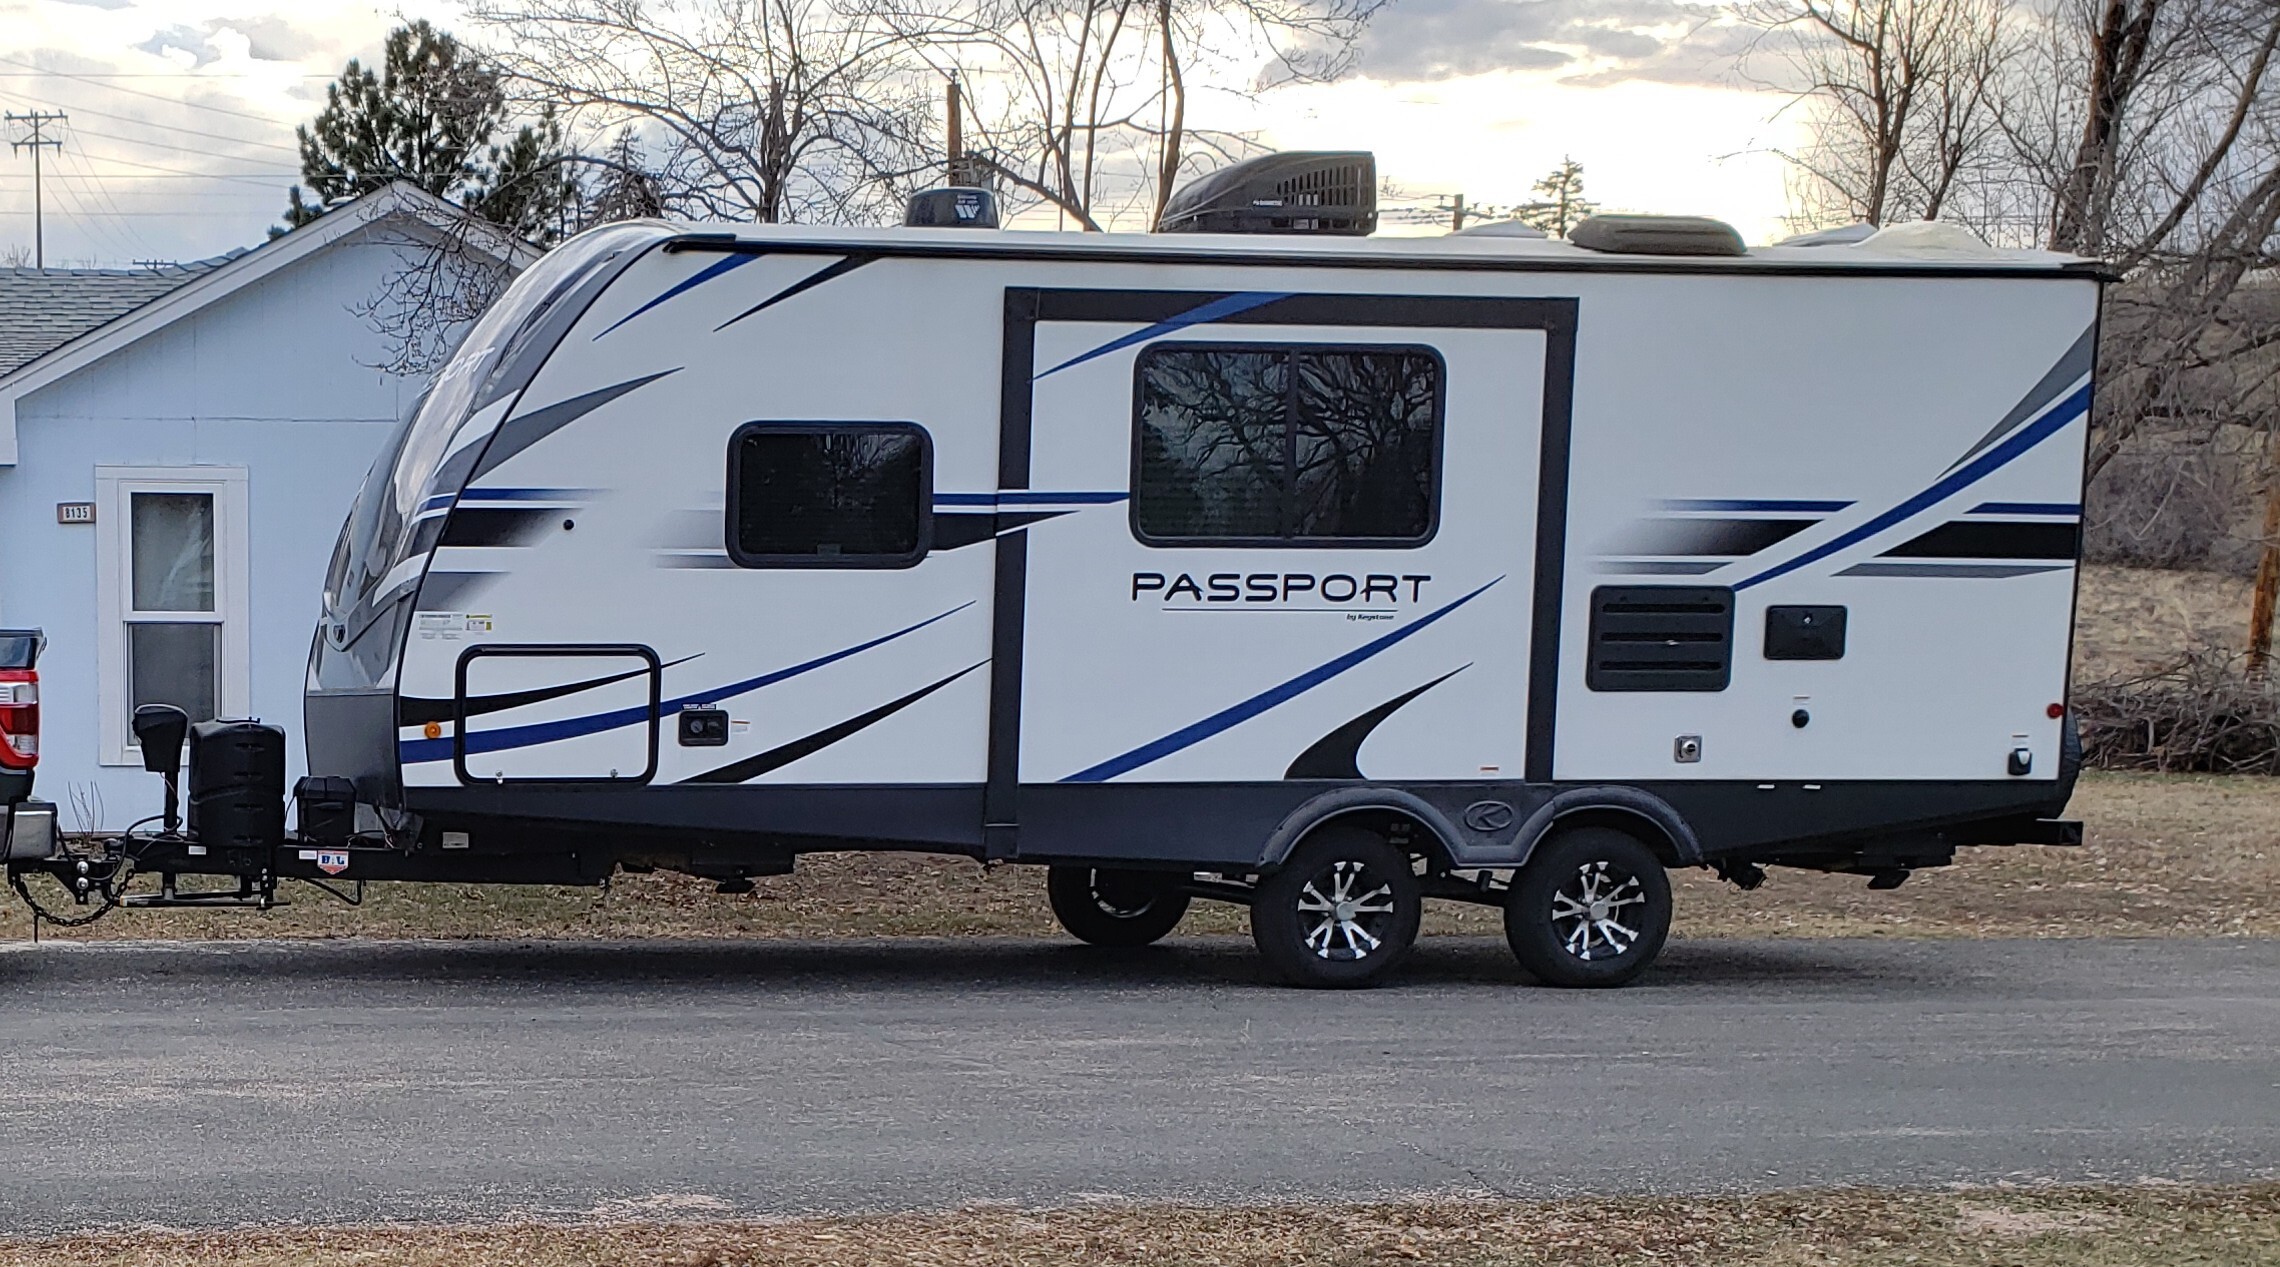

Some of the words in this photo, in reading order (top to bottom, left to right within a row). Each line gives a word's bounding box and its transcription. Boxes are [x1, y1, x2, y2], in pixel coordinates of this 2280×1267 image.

[65, 507, 87, 518] 8135
[1132, 573, 1431, 603] PASSPORT
[1346, 613, 1356, 621] by
